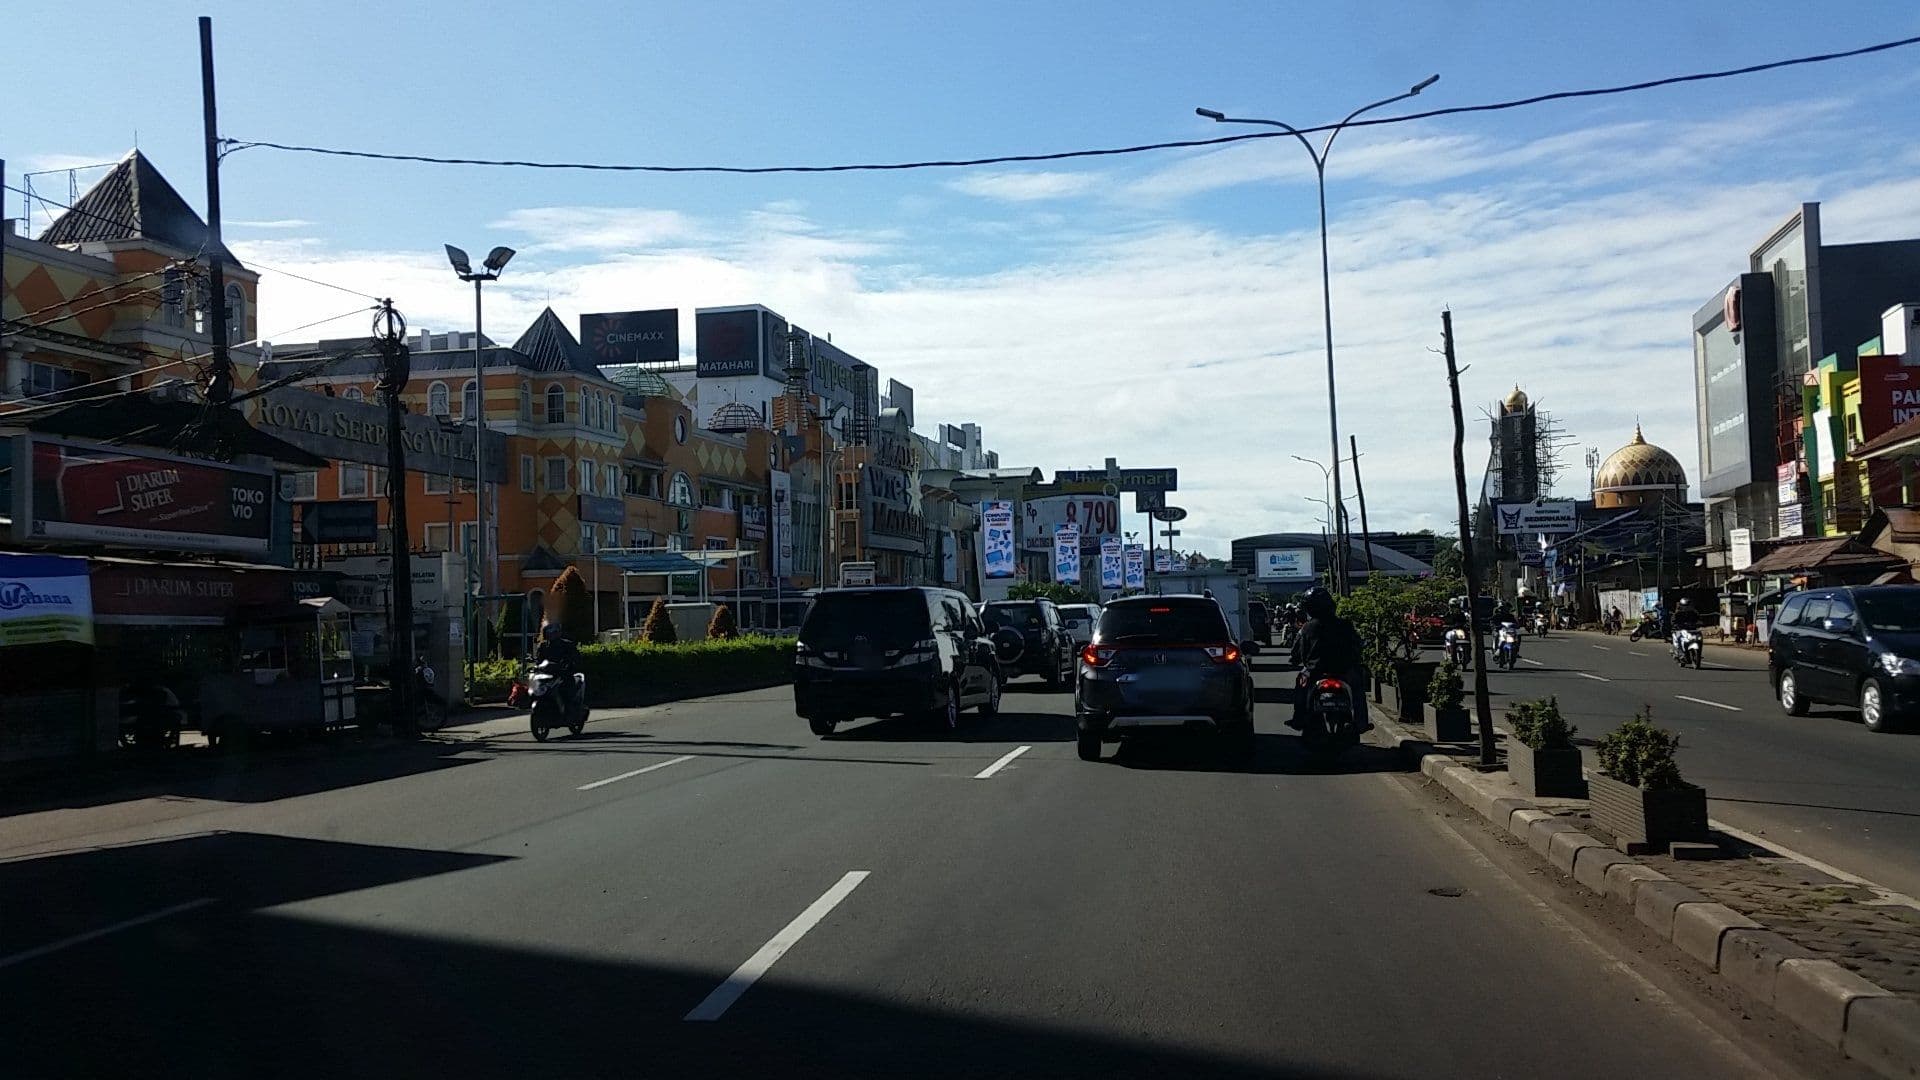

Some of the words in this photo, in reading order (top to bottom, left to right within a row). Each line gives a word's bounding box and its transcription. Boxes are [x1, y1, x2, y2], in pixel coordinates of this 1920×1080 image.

[606, 331, 664, 344] CINEMAXX
[699, 360, 754, 372] MATAHARI
[256, 397, 329, 435] ROYAL
[334, 412, 424, 453] SERPNG
[131, 488, 174, 512] SUPER
[232, 487, 265, 504] TOKO
[232, 504, 254, 519] VIO
[1026, 503, 1037, 523] Rp
[196, 580, 234, 597] SUPER
[291, 580, 321, 593] TOKO
[1, 586, 72, 606] Wahana
